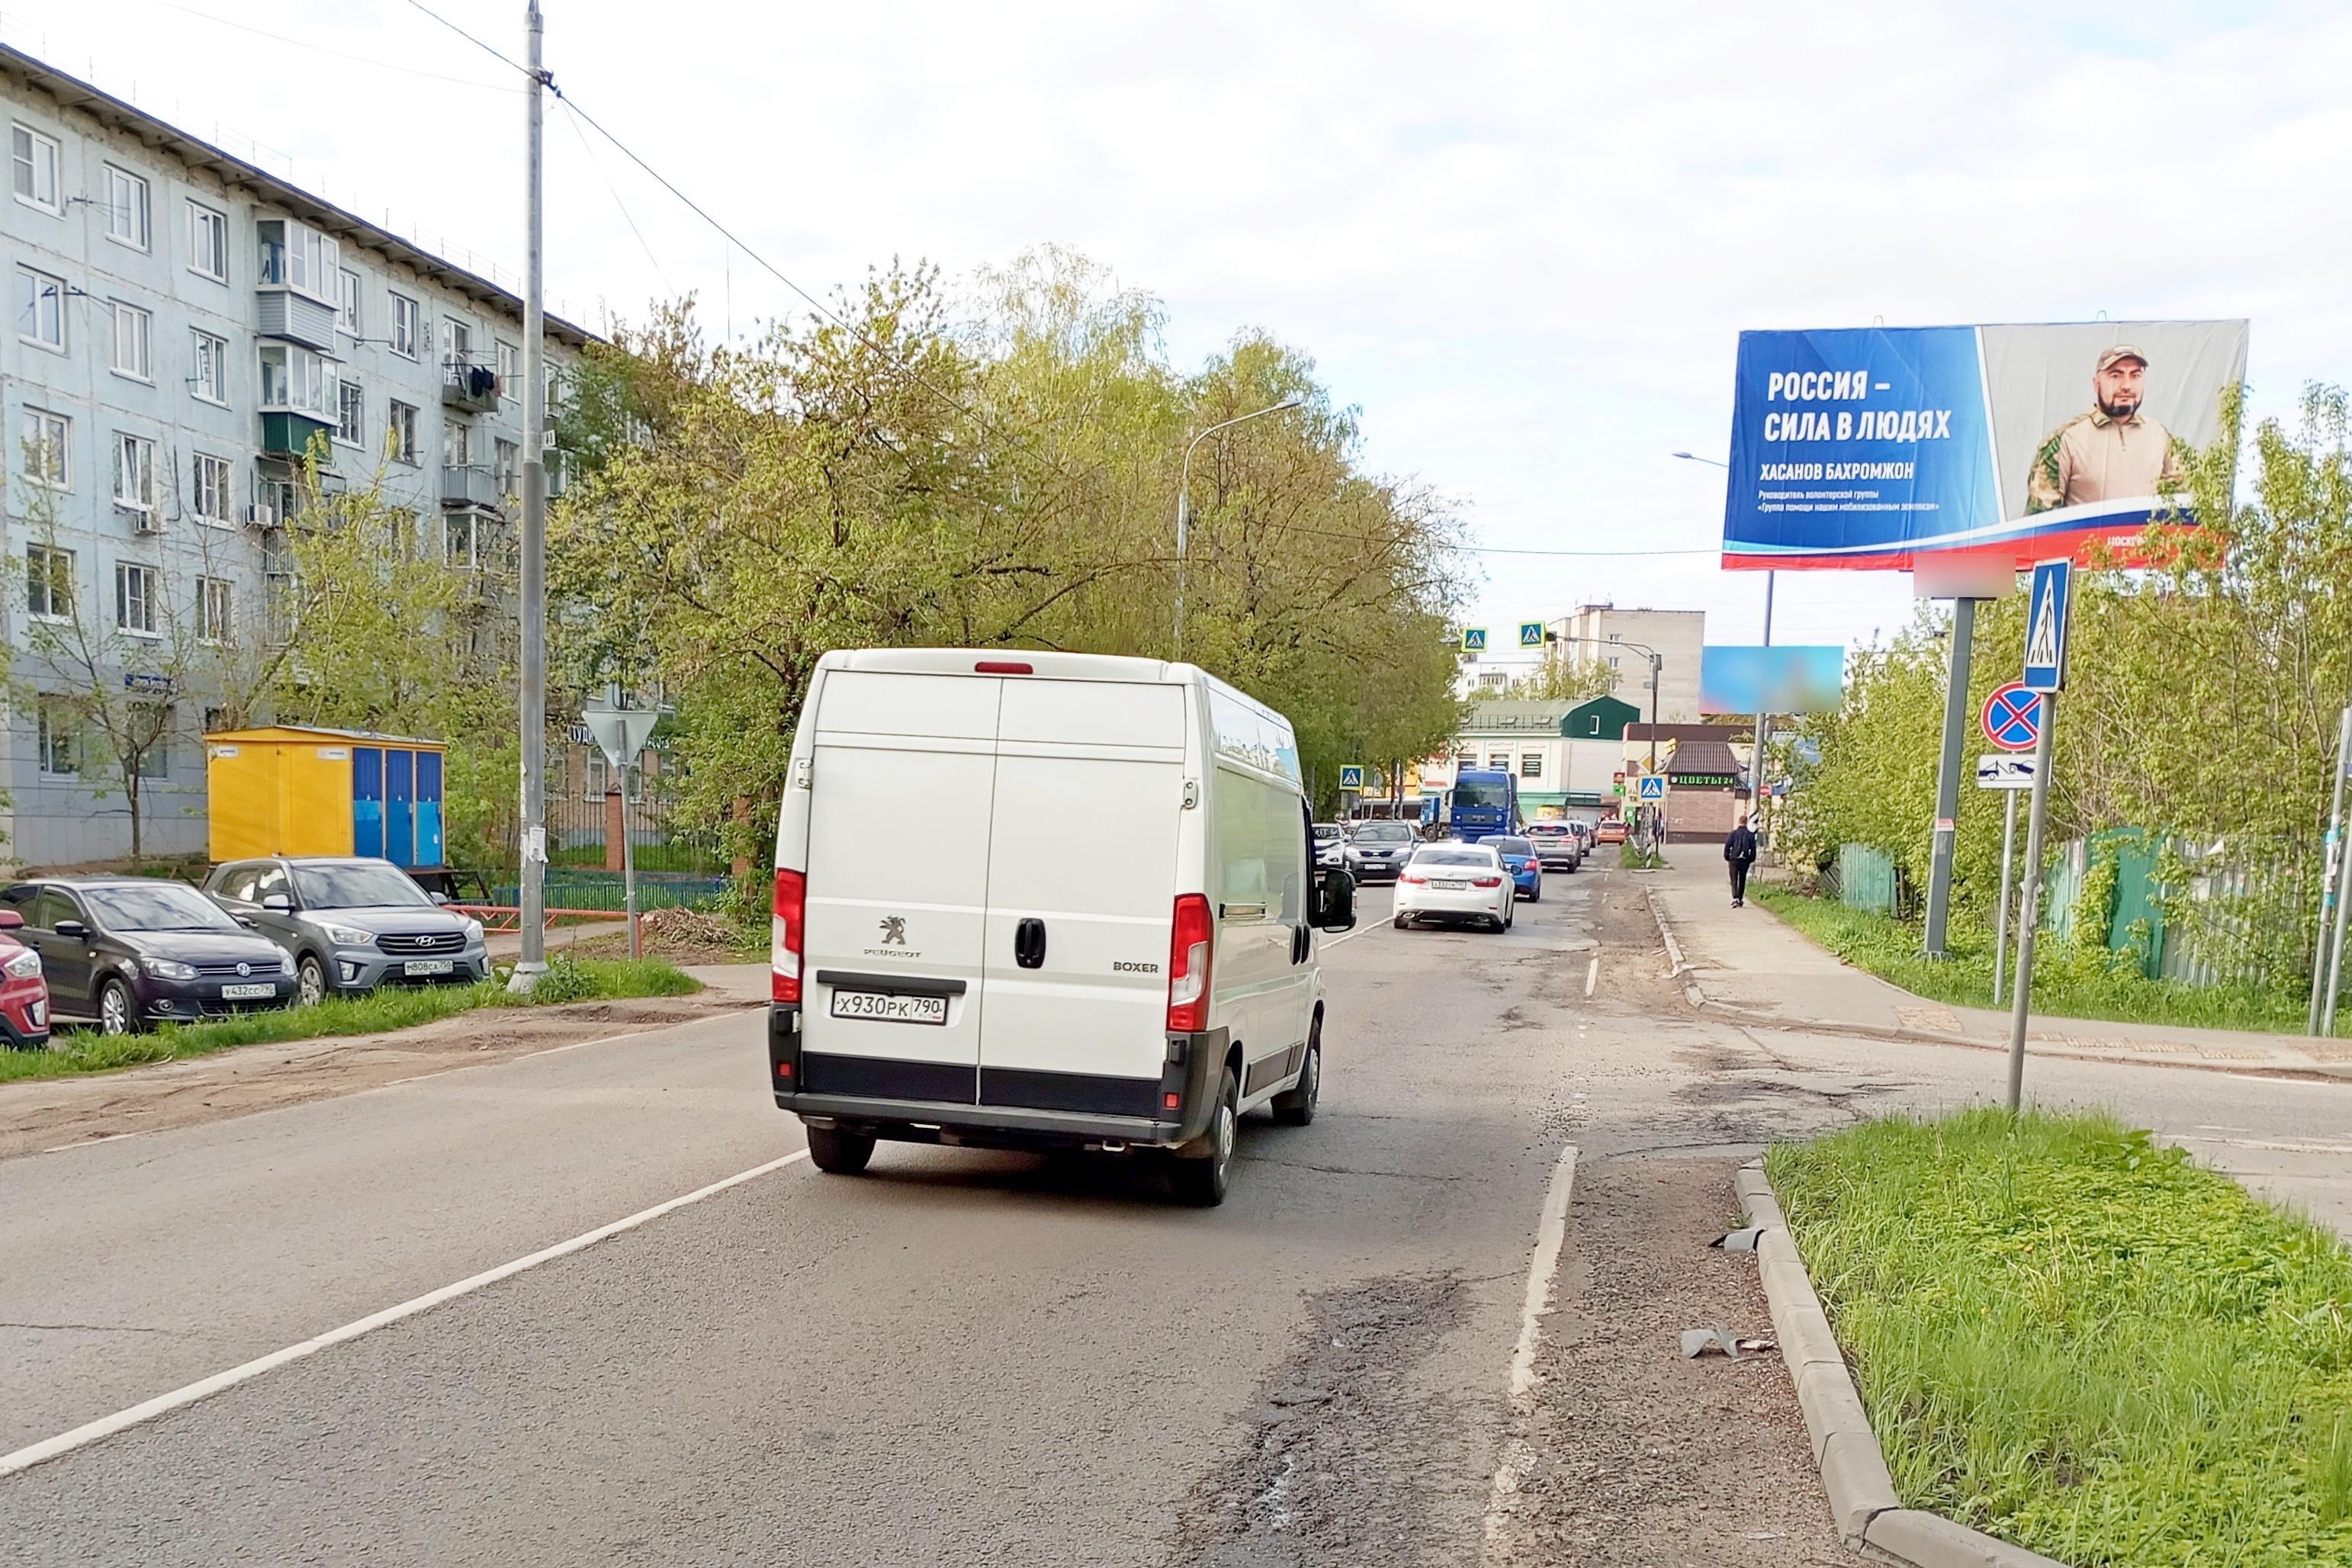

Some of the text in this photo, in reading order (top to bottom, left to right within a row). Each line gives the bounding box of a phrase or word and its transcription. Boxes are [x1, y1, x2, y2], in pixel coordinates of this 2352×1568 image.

[1767, 371, 1868, 401] РОССИЯ
[1764, 410, 1952, 443] СИЛА В ЛЮДЯХ
[1759, 461, 1914, 480] ХАСАНОВ БАХРОМЖОН
[1679, 775, 1733, 786] ЦВЕТЫ 24
[863, 949, 922, 958] PEUGEOT
[1113, 961, 1158, 973] BOXER
[839, 995, 941, 1017] Х930РК 790
